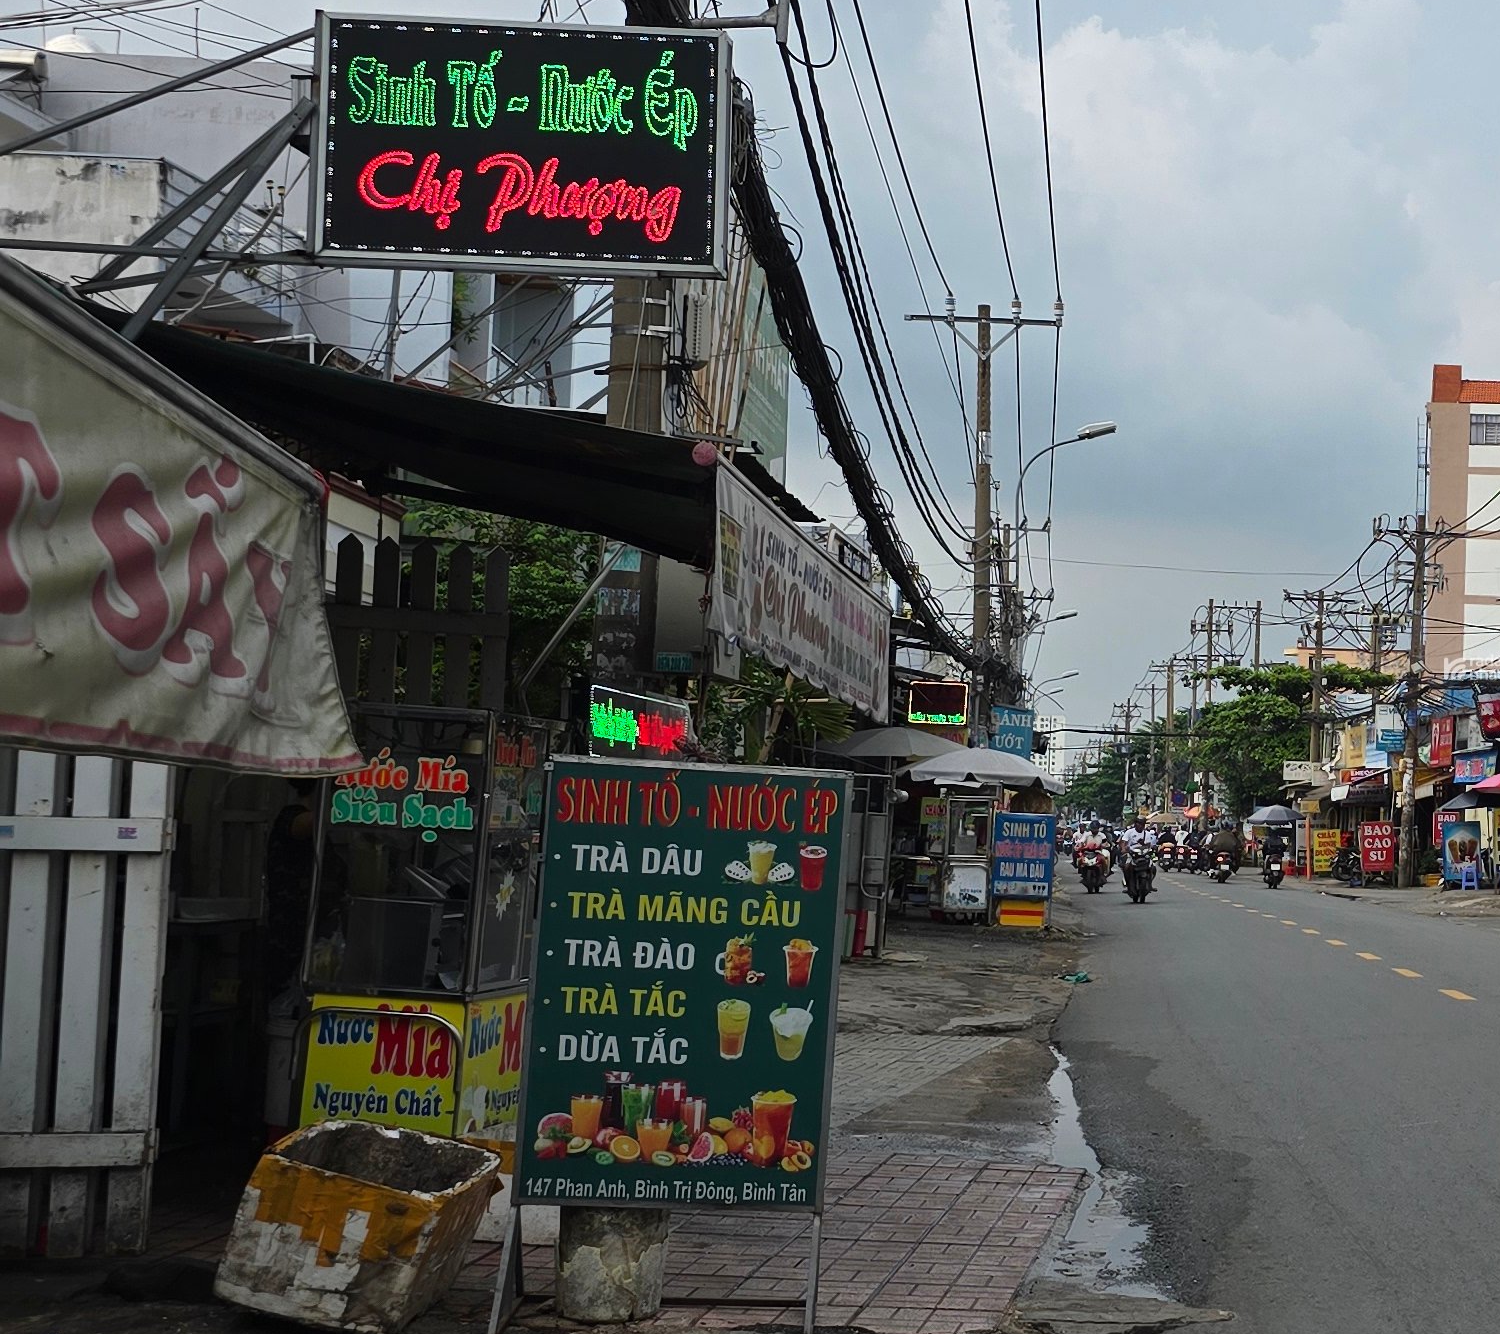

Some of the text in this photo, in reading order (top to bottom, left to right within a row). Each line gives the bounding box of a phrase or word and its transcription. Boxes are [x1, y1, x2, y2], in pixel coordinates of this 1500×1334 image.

[347, 56, 437, 127] Sinh
[446, 50, 504, 130] Tố
[538, 63, 635, 135] Nước
[644, 50, 698, 152] Ép
[357, 151, 683, 243] Chị Phượng
[997, 709, 1033, 727] ÁNH
[414, 755, 470, 794] Mía
[331, 786, 398, 826] Siêu
[401, 792, 475, 843] Sạch
[557, 775, 632, 826] SINH
[638, 769, 683, 828] TỐ
[706, 777, 798, 835] NƯỚC
[803, 778, 839, 835] ÉP
[1001, 821, 1030, 838] SINH
[1363, 825, 1392, 836] BAO
[1363, 838, 1392, 848] CAO
[571, 840, 703, 877] TRÀ DÂU
[1369, 850, 1387, 862] SU
[567, 887, 802, 928] TRÀ MÃNG CẦU
[563, 935, 696, 971] TRÀ ĐÀO
[560, 980, 688, 1018] TRÀ TẮC
[557, 1029, 621, 1064] DỪA
[631, 1027, 689, 1066] TẮC
[312, 1081, 444, 1118] Nguyên Chất
[525, 1177, 808, 1205] 147 Phan Anh, Bình Trị Đông, Bình Tân
